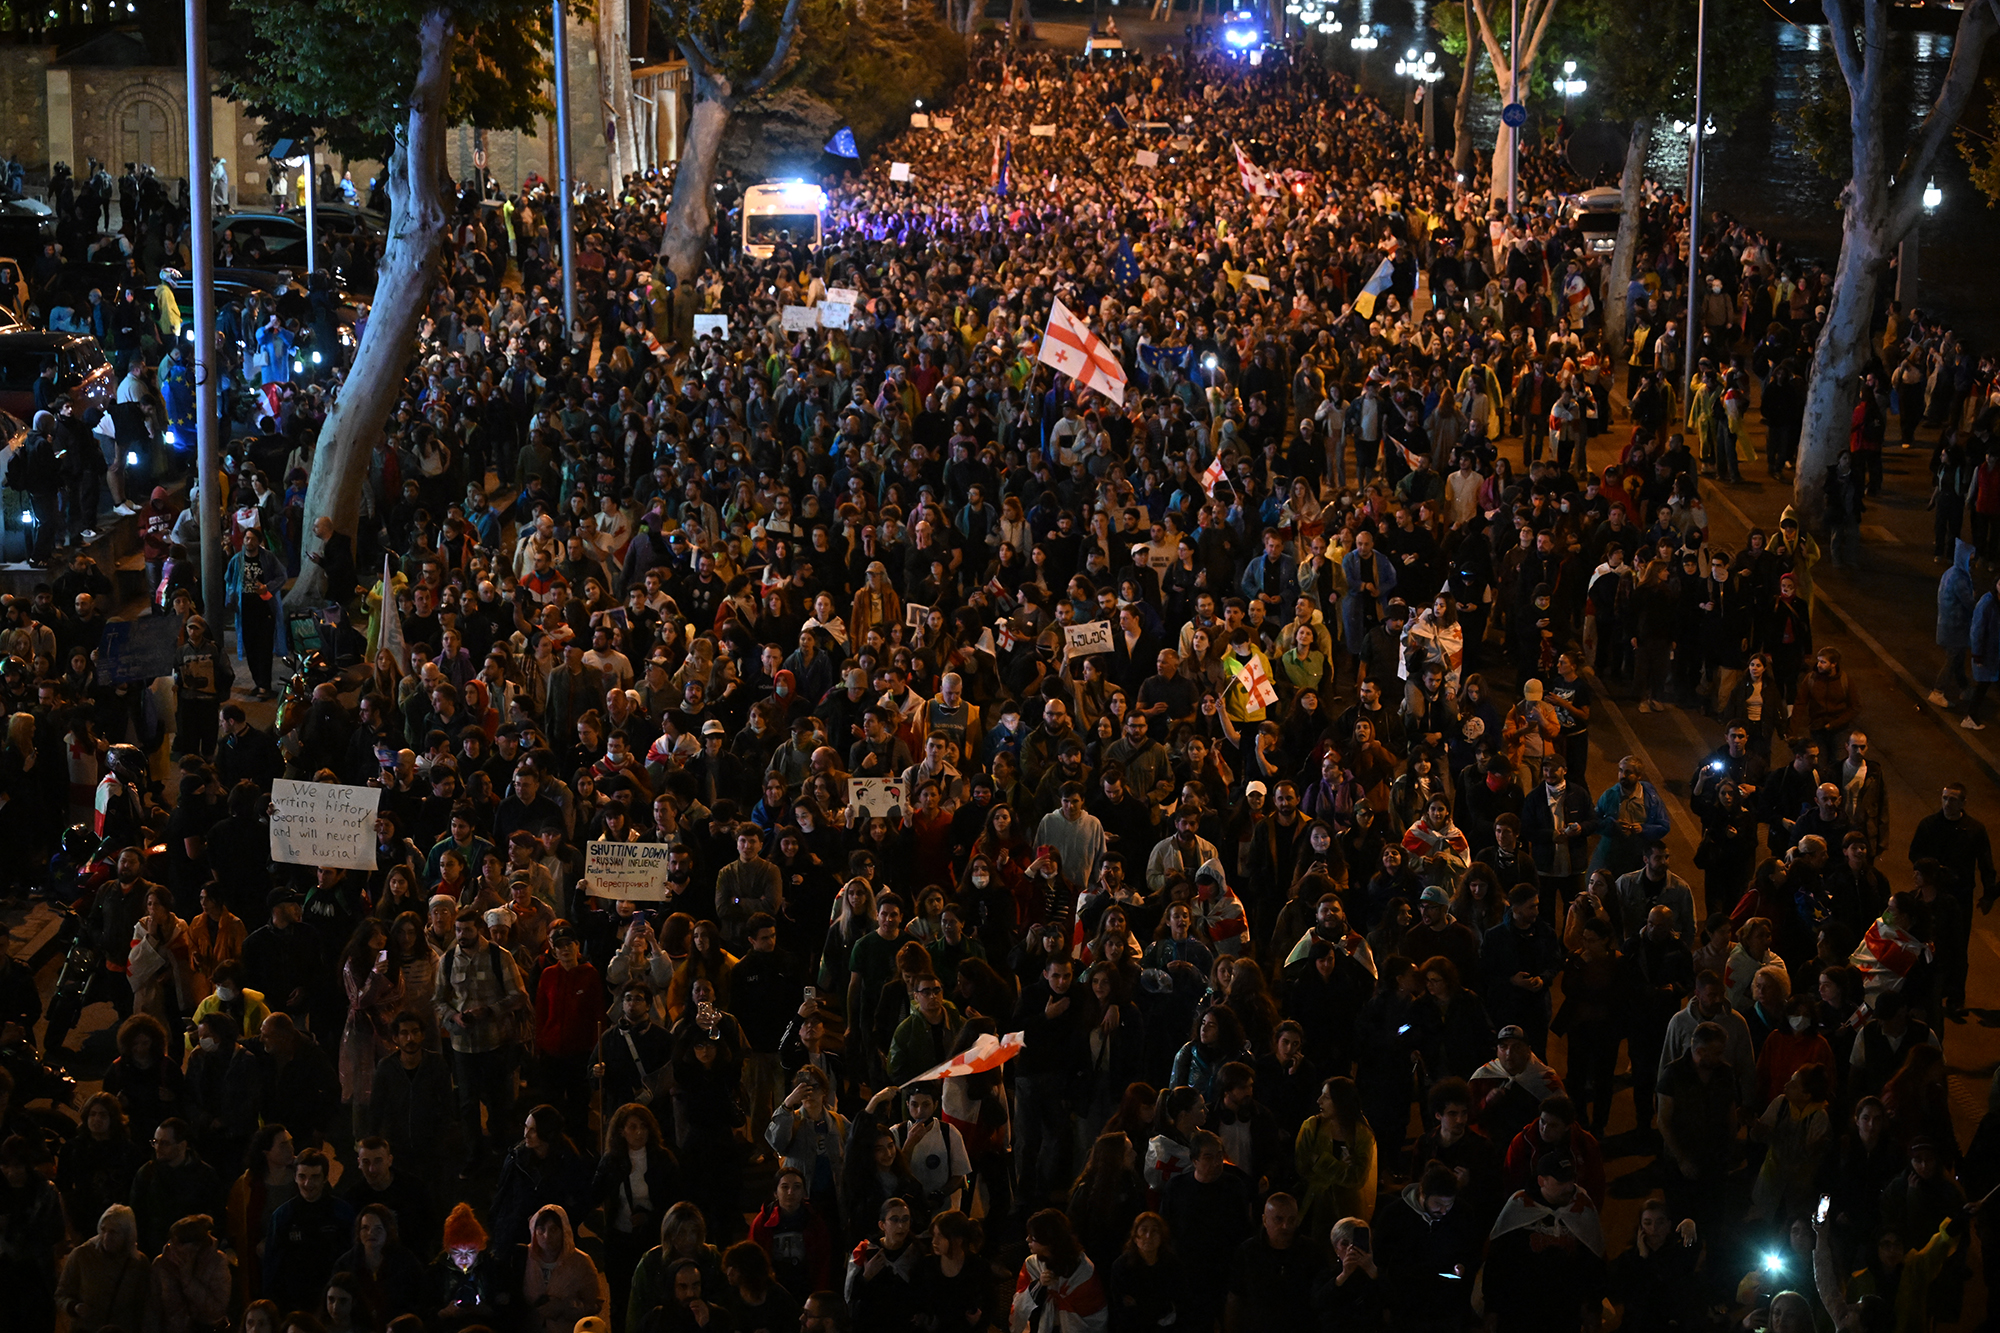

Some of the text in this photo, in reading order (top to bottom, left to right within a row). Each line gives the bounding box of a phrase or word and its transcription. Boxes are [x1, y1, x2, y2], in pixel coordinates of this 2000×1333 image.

[292, 782, 354, 800] We are
[272, 797, 372, 821] writing history
[272, 809, 362, 828] Georgia is not
[273, 826, 361, 843] and will never
[288, 844, 357, 860] be Russia!
[590, 844, 668, 859] SHUTTING DOWN
[587, 865, 604, 874] Faster
[596, 857, 660, 869] RUSSIAN INFLUENCE
